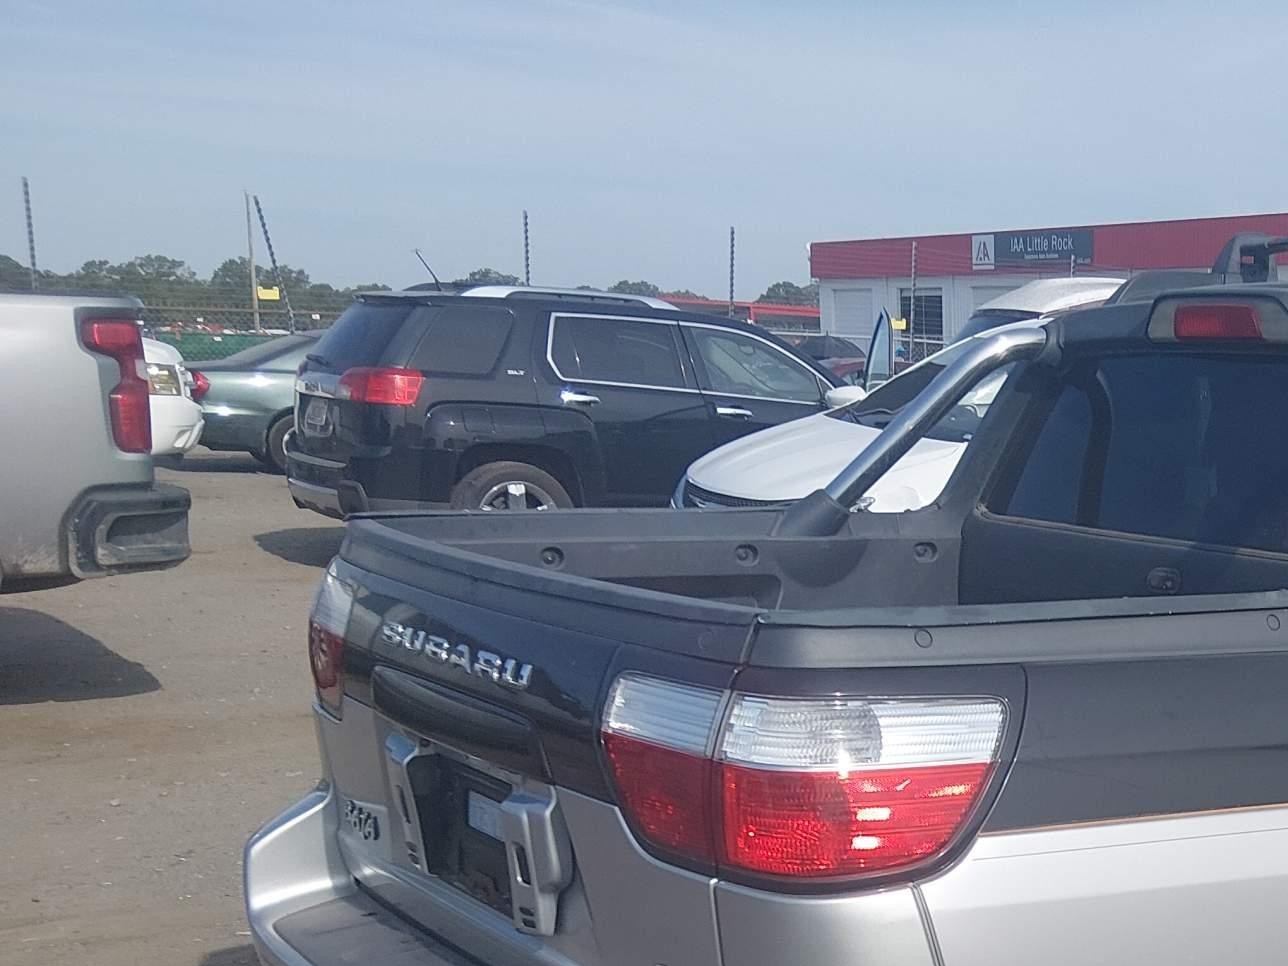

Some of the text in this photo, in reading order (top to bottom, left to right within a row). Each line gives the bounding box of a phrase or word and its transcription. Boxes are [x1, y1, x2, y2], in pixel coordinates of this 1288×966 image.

[1010, 235, 1074, 252] IAA Little Rock
[380, 621, 533, 688] SUBARU
